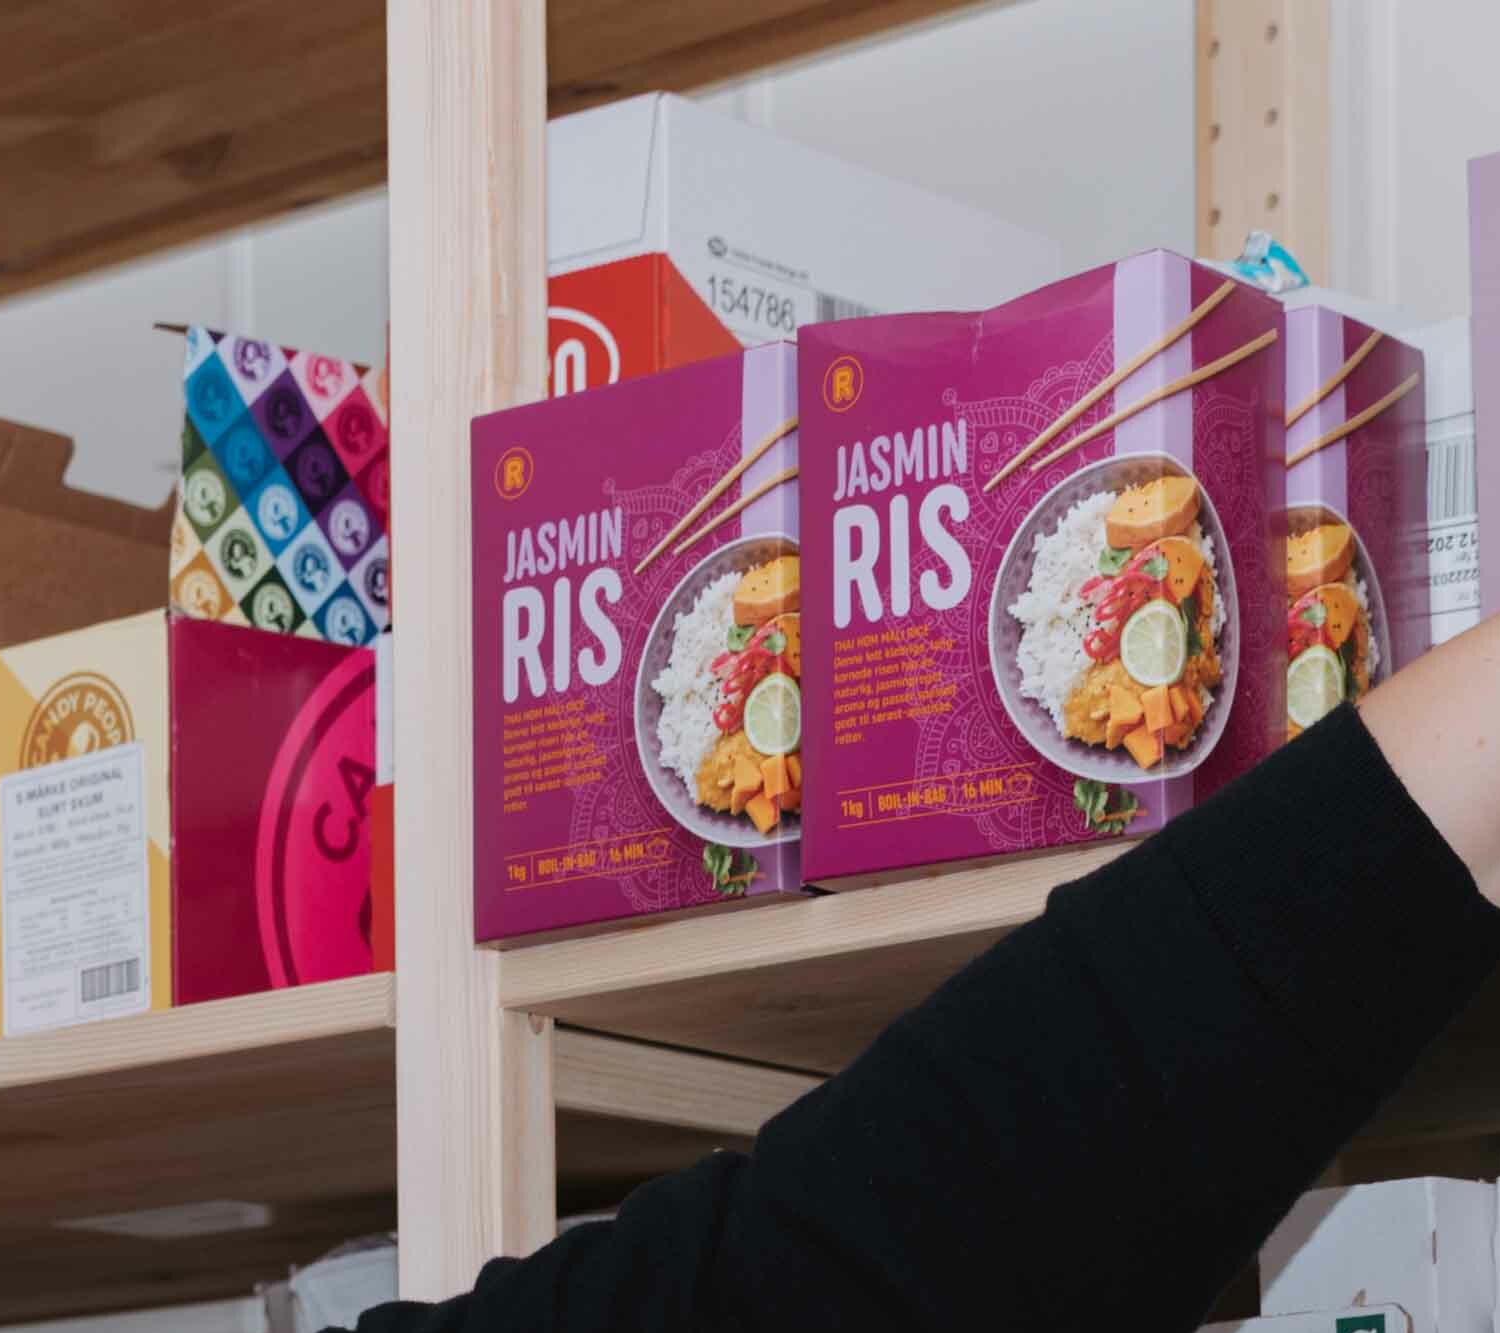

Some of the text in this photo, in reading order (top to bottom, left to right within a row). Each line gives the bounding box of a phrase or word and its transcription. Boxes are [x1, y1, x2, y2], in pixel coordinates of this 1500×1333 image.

[707, 275, 796, 333] 154786
[833, 417, 968, 502] JASMIN
[503, 506, 623, 583] JASMIN
[833, 483, 972, 629] RIS
[503, 567, 623, 703] RIS
